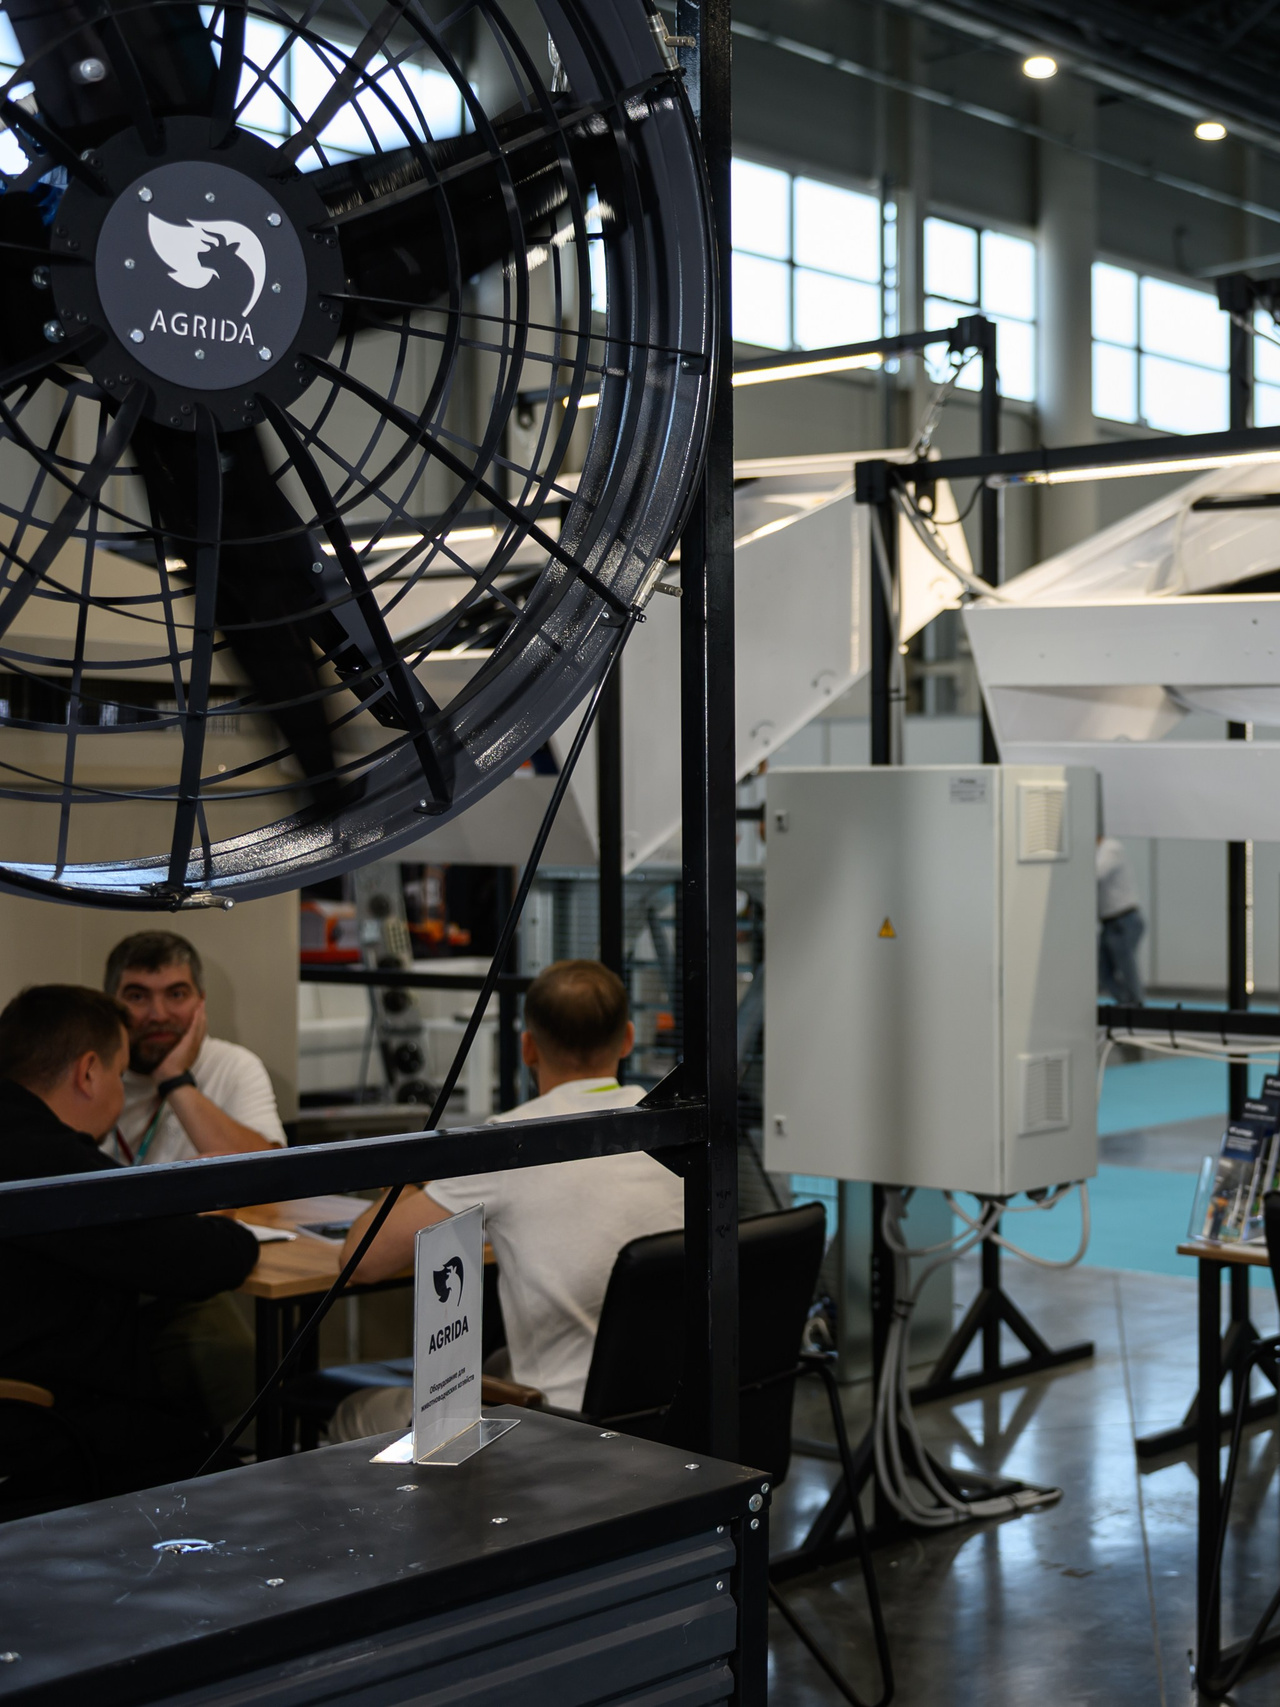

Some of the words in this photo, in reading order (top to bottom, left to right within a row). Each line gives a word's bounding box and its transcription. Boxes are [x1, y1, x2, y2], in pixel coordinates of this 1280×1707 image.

[149, 308, 255, 346] AGRIDA
[428, 1315, 469, 1355] AGRIDA
[429, 1372, 458, 1394] Оборудование
[458, 1367, 466, 1380] для
